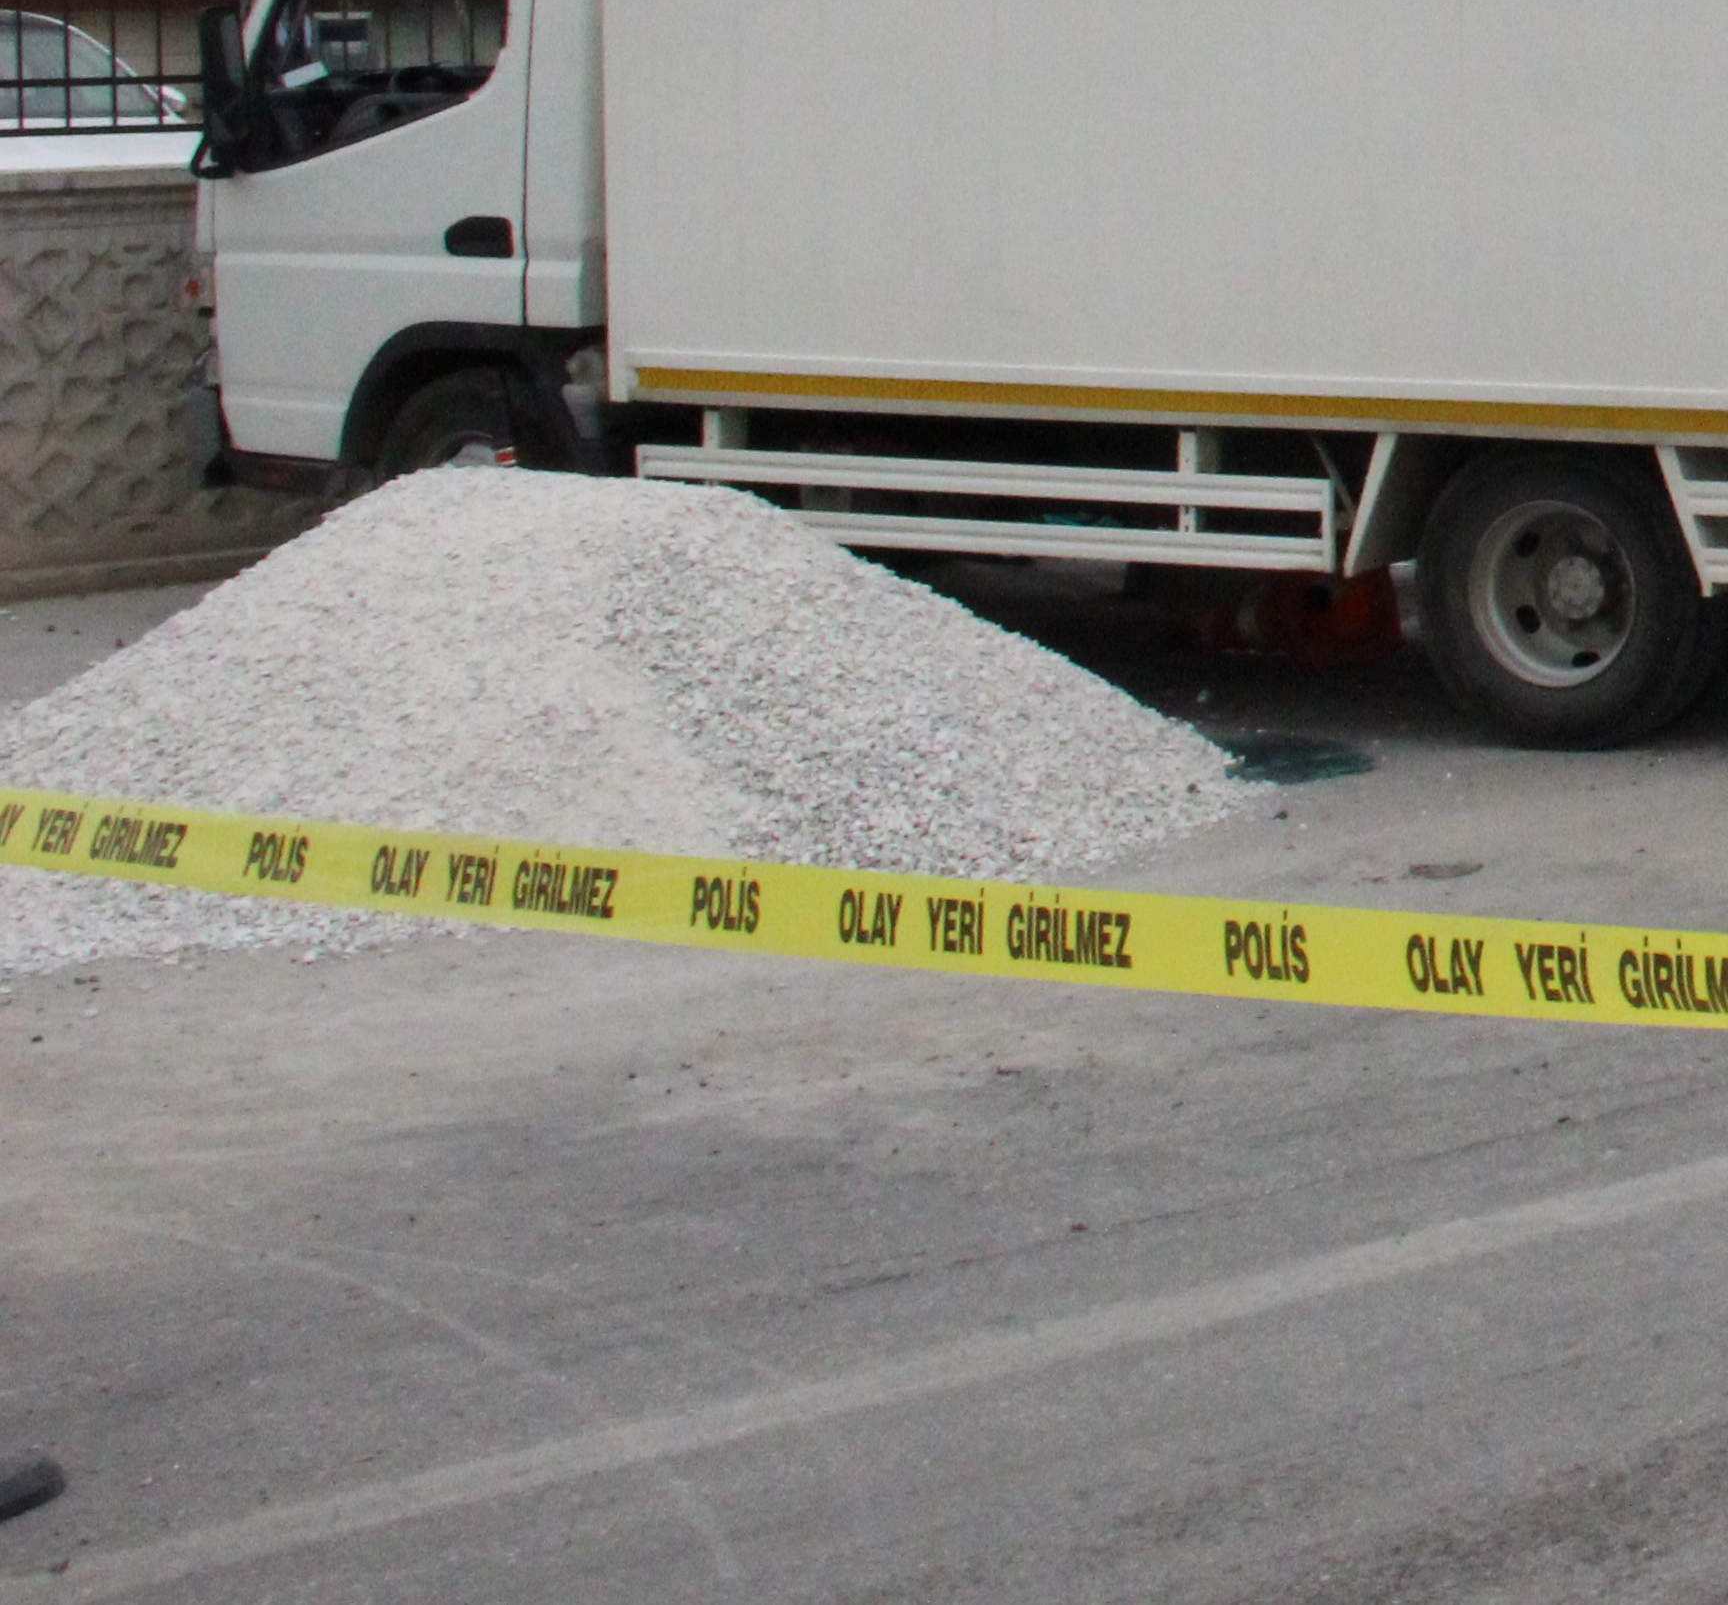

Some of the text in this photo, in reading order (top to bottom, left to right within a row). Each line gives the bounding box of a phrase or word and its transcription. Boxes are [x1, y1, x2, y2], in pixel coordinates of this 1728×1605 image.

[32, 802, 88, 855] YERİ
[90, 806, 188, 868] GİRİLMEZ
[242, 827, 309, 884] POLİS
[371, 845, 430, 897] OLAY
[447, 846, 499, 906] YERİ
[513, 850, 618, 920] GİRİLMEZ
[690, 868, 760, 934] POLİS
[839, 889, 902, 946] OLAY
[927, 887, 985, 955] YERİ
[1007, 893, 1131, 968] GİRİLMEZ
[1225, 911, 1309, 983] POLİS
[1406, 934, 1484, 995] OLAY
[1515, 932, 1595, 1003] YERİ
